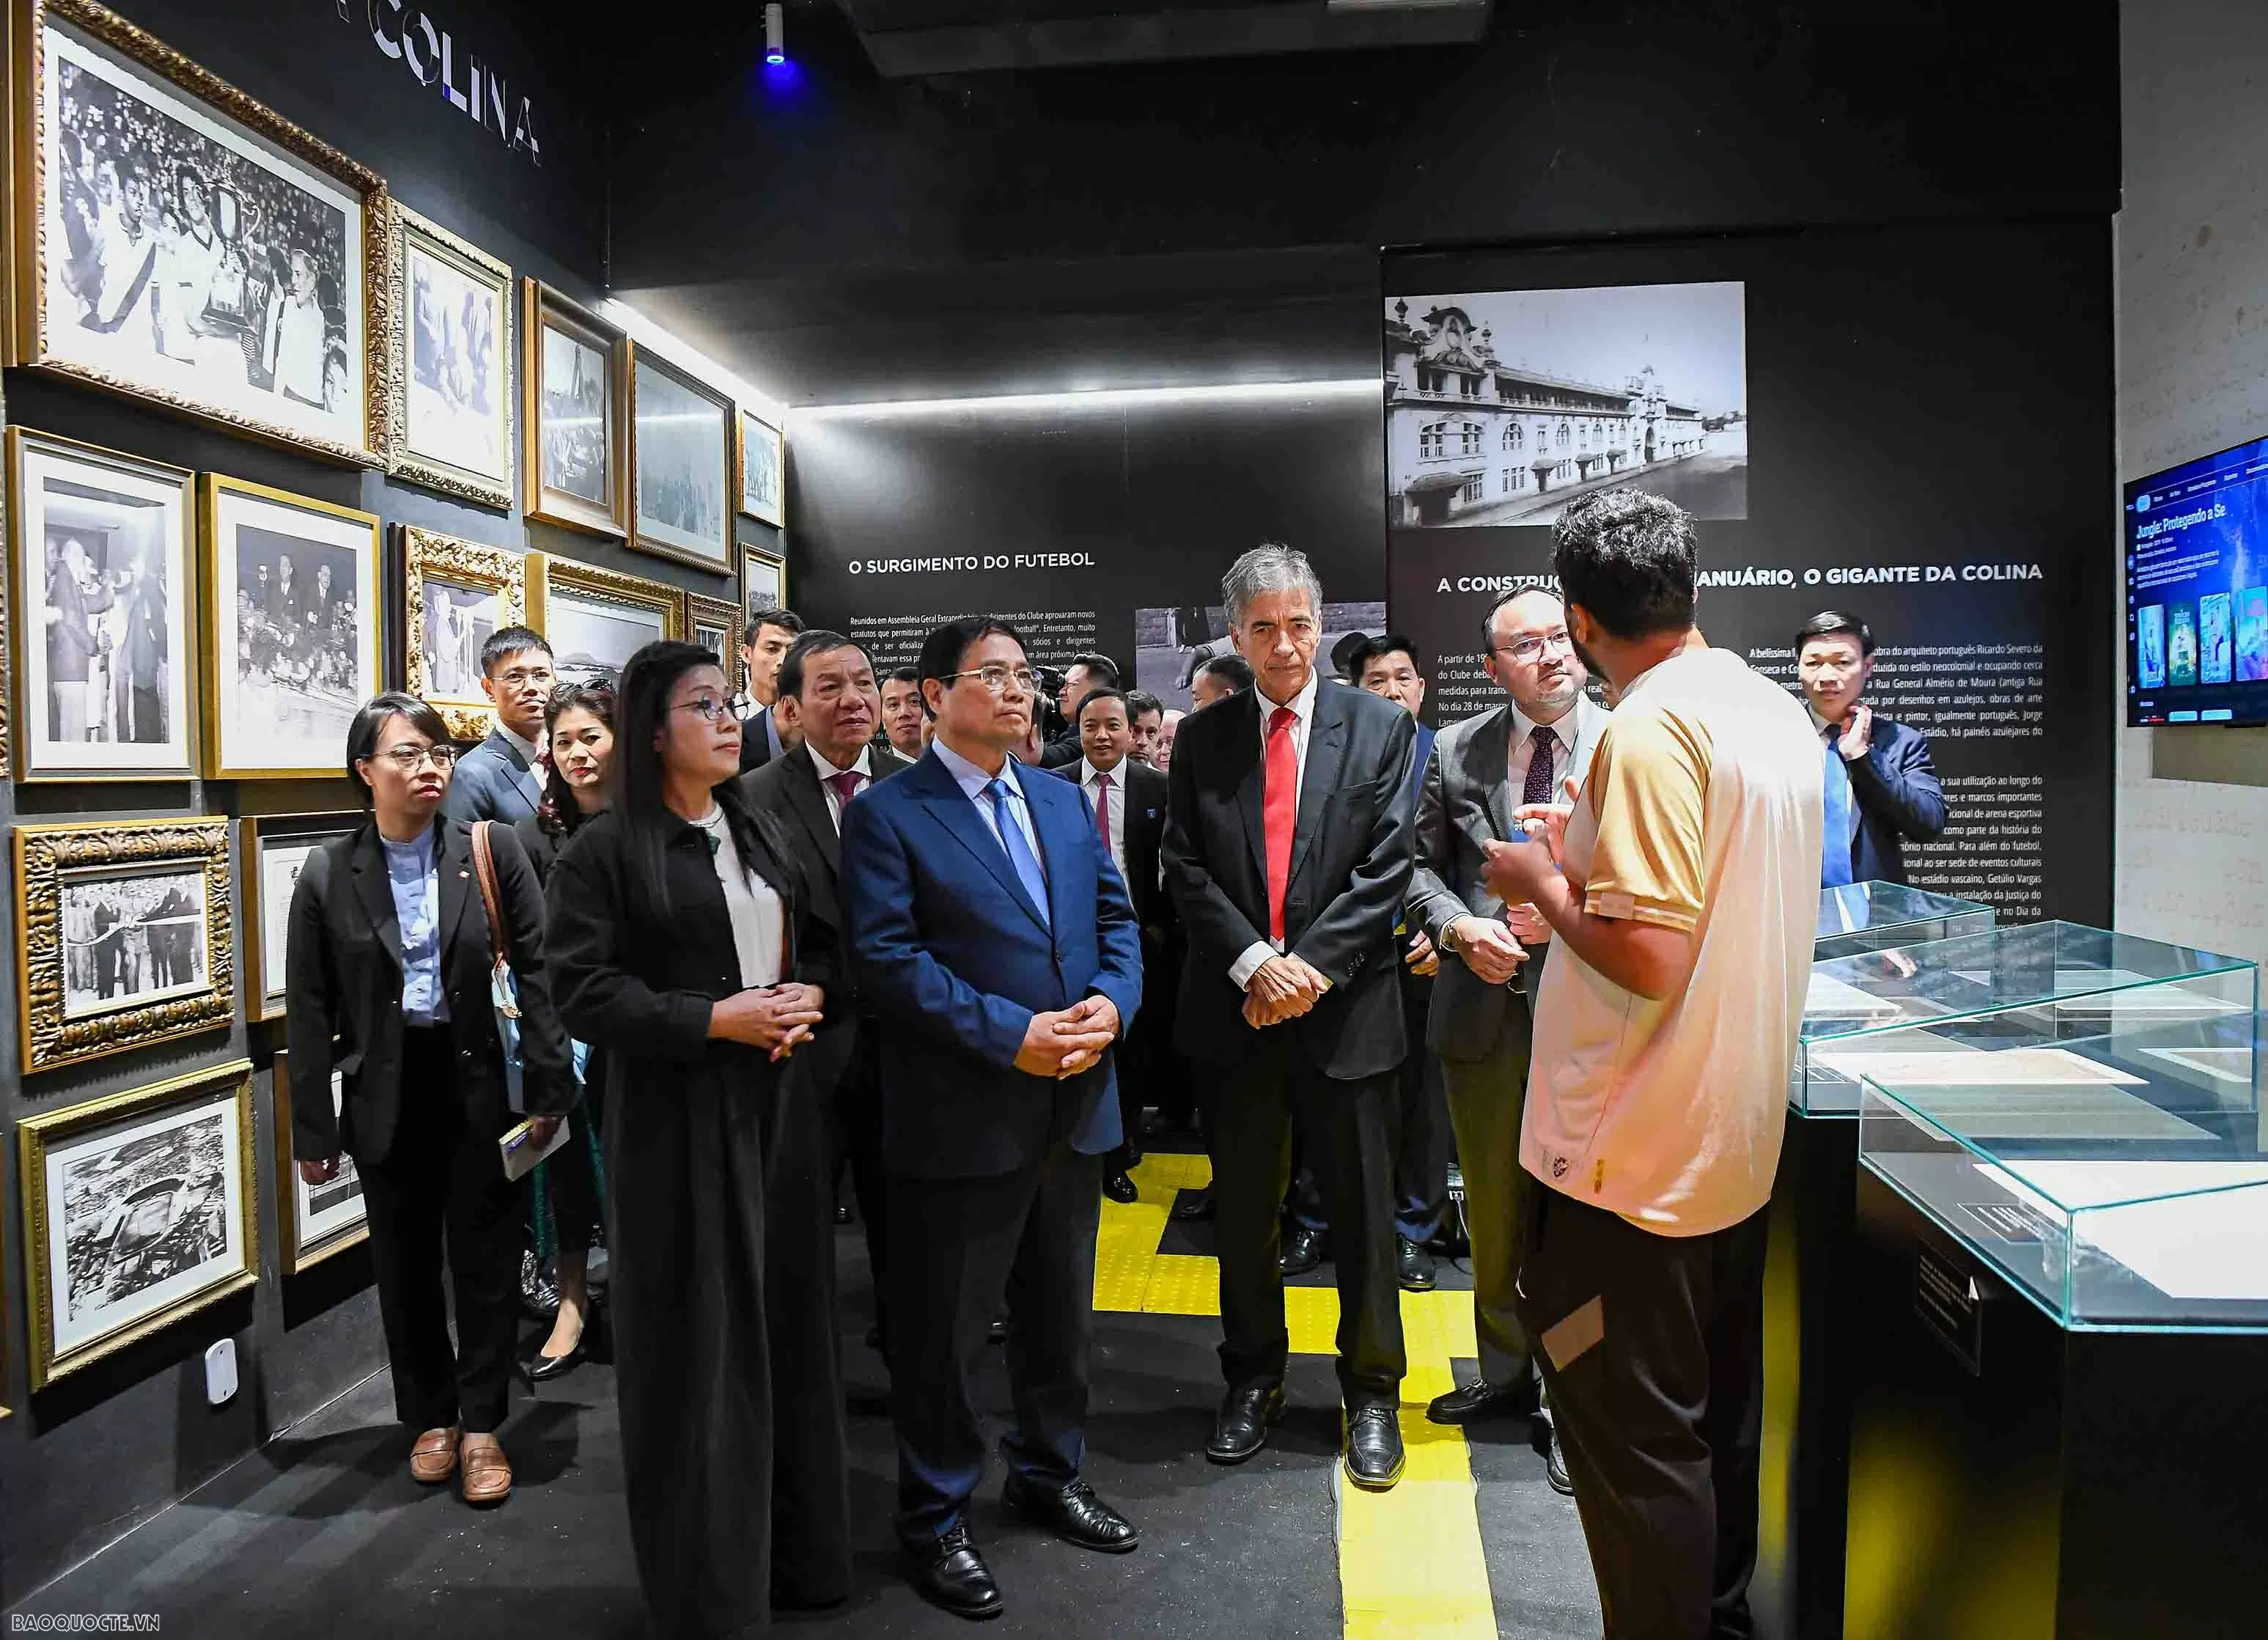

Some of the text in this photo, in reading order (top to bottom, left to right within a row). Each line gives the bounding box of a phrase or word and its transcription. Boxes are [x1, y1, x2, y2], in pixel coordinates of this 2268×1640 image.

[368, 0, 541, 167] COLINA
[2163, 508, 2206, 530] Protegendo
[849, 552, 1096, 574] O SURGIMENTO DO FUTEBOL
[1803, 568, 1822, 585] O
[1826, 567, 1921, 584] GIGANTE
[1925, 565, 1957, 582] DA
[1962, 564, 2044, 581] COLINA
[1437, 575, 1561, 592] A CONSTRU
[850, 616, 877, 625] Reunidos
[878, 617, 887, 625] em
[888, 614, 920, 624] Assembleia
[921, 614, 936, 623] Geral
[1018, 611, 1026, 620] do
[1026, 611, 1044, 620] Clube
[1045, 611, 1077, 621] aprovaram
[1078, 611, 1096, 619] novos
[850, 630, 877, 639] estatutos
[878, 630, 889, 639] que
[891, 628, 924, 639] permitiram
[1043, 624, 1075, 633] Entretanto,
[1078, 623, 1096, 632] muito
[872, 641, 924, 650] de ser oficializa
[1033, 637, 1051, 646] sócios
[1066, 636, 1096, 647] dirigentes
[1035, 650, 1049, 658] área
[1050, 650, 1075, 660] próxima
[1893, 646, 1903, 655] do
[1904, 646, 1937, 657] arquiteto
[1938, 644, 1976, 657] português
[1978, 644, 2006, 655] Ricardo
[2007, 643, 2032, 654] Severo
[2033, 643, 2043, 653] da
[1437, 655, 1443, 663] A
[1444, 654, 1463, 666] partir
[1465, 653, 1475, 663] de
[1899, 663, 1910, 672] no
[1911, 662, 1931, 672] estilo
[1933, 661, 1976, 672] neocolonial
[1978, 662, 1983, 671] e
[1984, 658, 2022, 672] ocupando
[2023, 661, 2043, 669] cerca
[1437, 669, 1491, 680] do Clube deba
[1876, 679, 1890, 689] Rua
[1893, 678, 1923, 688] General
[1926, 677, 1955, 688] Almério
[1958, 677, 1968, 688] de
[1970, 677, 1996, 687] Moura
[2028, 677, 2043, 686] Rua
[1438, 685, 1469, 696] medidas
[1470, 687, 1487, 697] para
[1438, 702, 1449, 711] No
[1450, 702, 1462, 711] dia
[1462, 702, 1473, 711] 28
[1473, 701, 1483, 710] de
[1882, 696, 1896, 707] por
[1899, 694, 1935, 705] desenhos
[1938, 696, 1951, 705] em
[1989, 694, 2011, 703] obras
[2014, 694, 2024, 703] de
[2028, 694, 2042, 703] arte
[1896, 713, 1903, 721] e
[1905, 712, 1931, 722] pintor,
[1934, 710, 1976, 723] igualmente
[2023, 710, 2043, 721] Jorge
[1951, 726, 1962, 737] há
[1963, 726, 1991, 739] painéis
[1993, 726, 2030, 738] azulejares
[2032, 725, 2043, 735] do
[1946, 778, 1961, 786] sua
[1962, 776, 1997, 788] utilização
[1998, 777, 2008, 785] ao
[2010, 775, 2030, 787] longo
[2032, 775, 2043, 784] do
[1968, 793, 1995, 802] marcos
[1998, 792, 2042, 804] importantes
[1974, 809, 1984, 818] de
[1985, 810, 2007, 818] arena
[2009, 809, 2042, 820] esportiva
[1943, 823, 2042, 836] como parte da história do
[1923, 841, 1957, 851] nacional.
[1959, 841, 1976, 850] Para
[1978, 840, 1998, 850] além
[2000, 841, 2011, 850] do
[1924, 859, 1934, 867] ao
[1935, 859, 1948, 867] ser
[1948, 858, 1967, 867] sede
[1968, 857, 1978, 867] de
[1981, 858, 2009, 867] eventos
[2011, 857, 2042, 867] culturais
[1907, 874, 1920, 884] No
[1922, 872, 1949, 884] estádio
[1988, 872, 2015, 883] Getúlio
[2017, 873, 2042, 886] Vargas
[1956, 889, 1992, 902] instalação
[1994, 889, 2004, 900] da
[2006, 890, 2030, 902] Justiça
[2031, 889, 2041, 900] do
[2003, 908, 2014, 916] no
[2017, 906, 2029, 916] Dia
[2031, 905, 2041, 916] da
